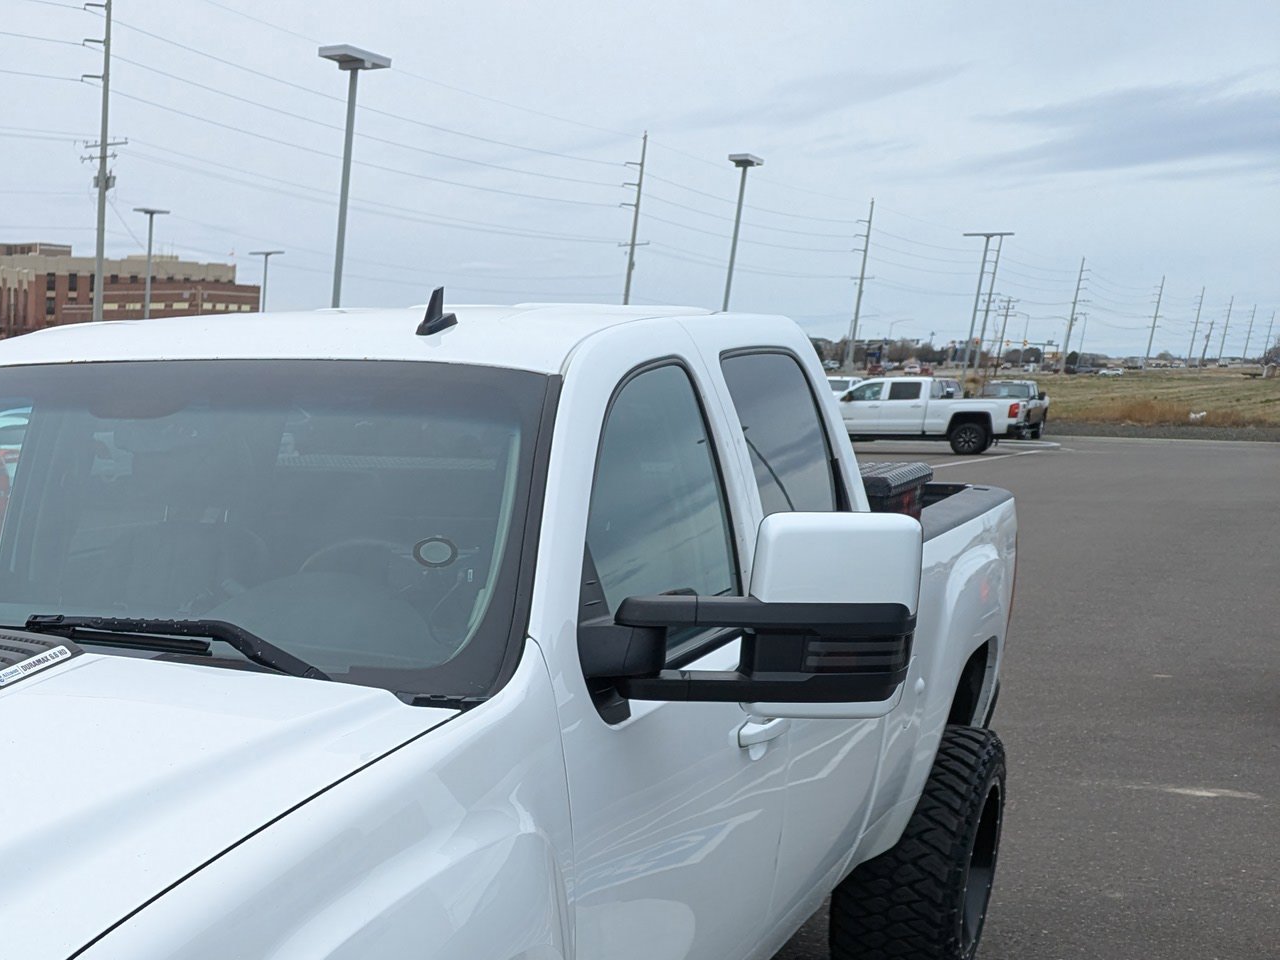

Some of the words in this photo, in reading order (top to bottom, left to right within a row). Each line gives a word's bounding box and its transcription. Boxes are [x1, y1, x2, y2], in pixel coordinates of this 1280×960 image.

[20, 655, 51, 672] DURAMAX
[48, 651, 60, 660] 6.6
[57, 648, 68, 656] HD
